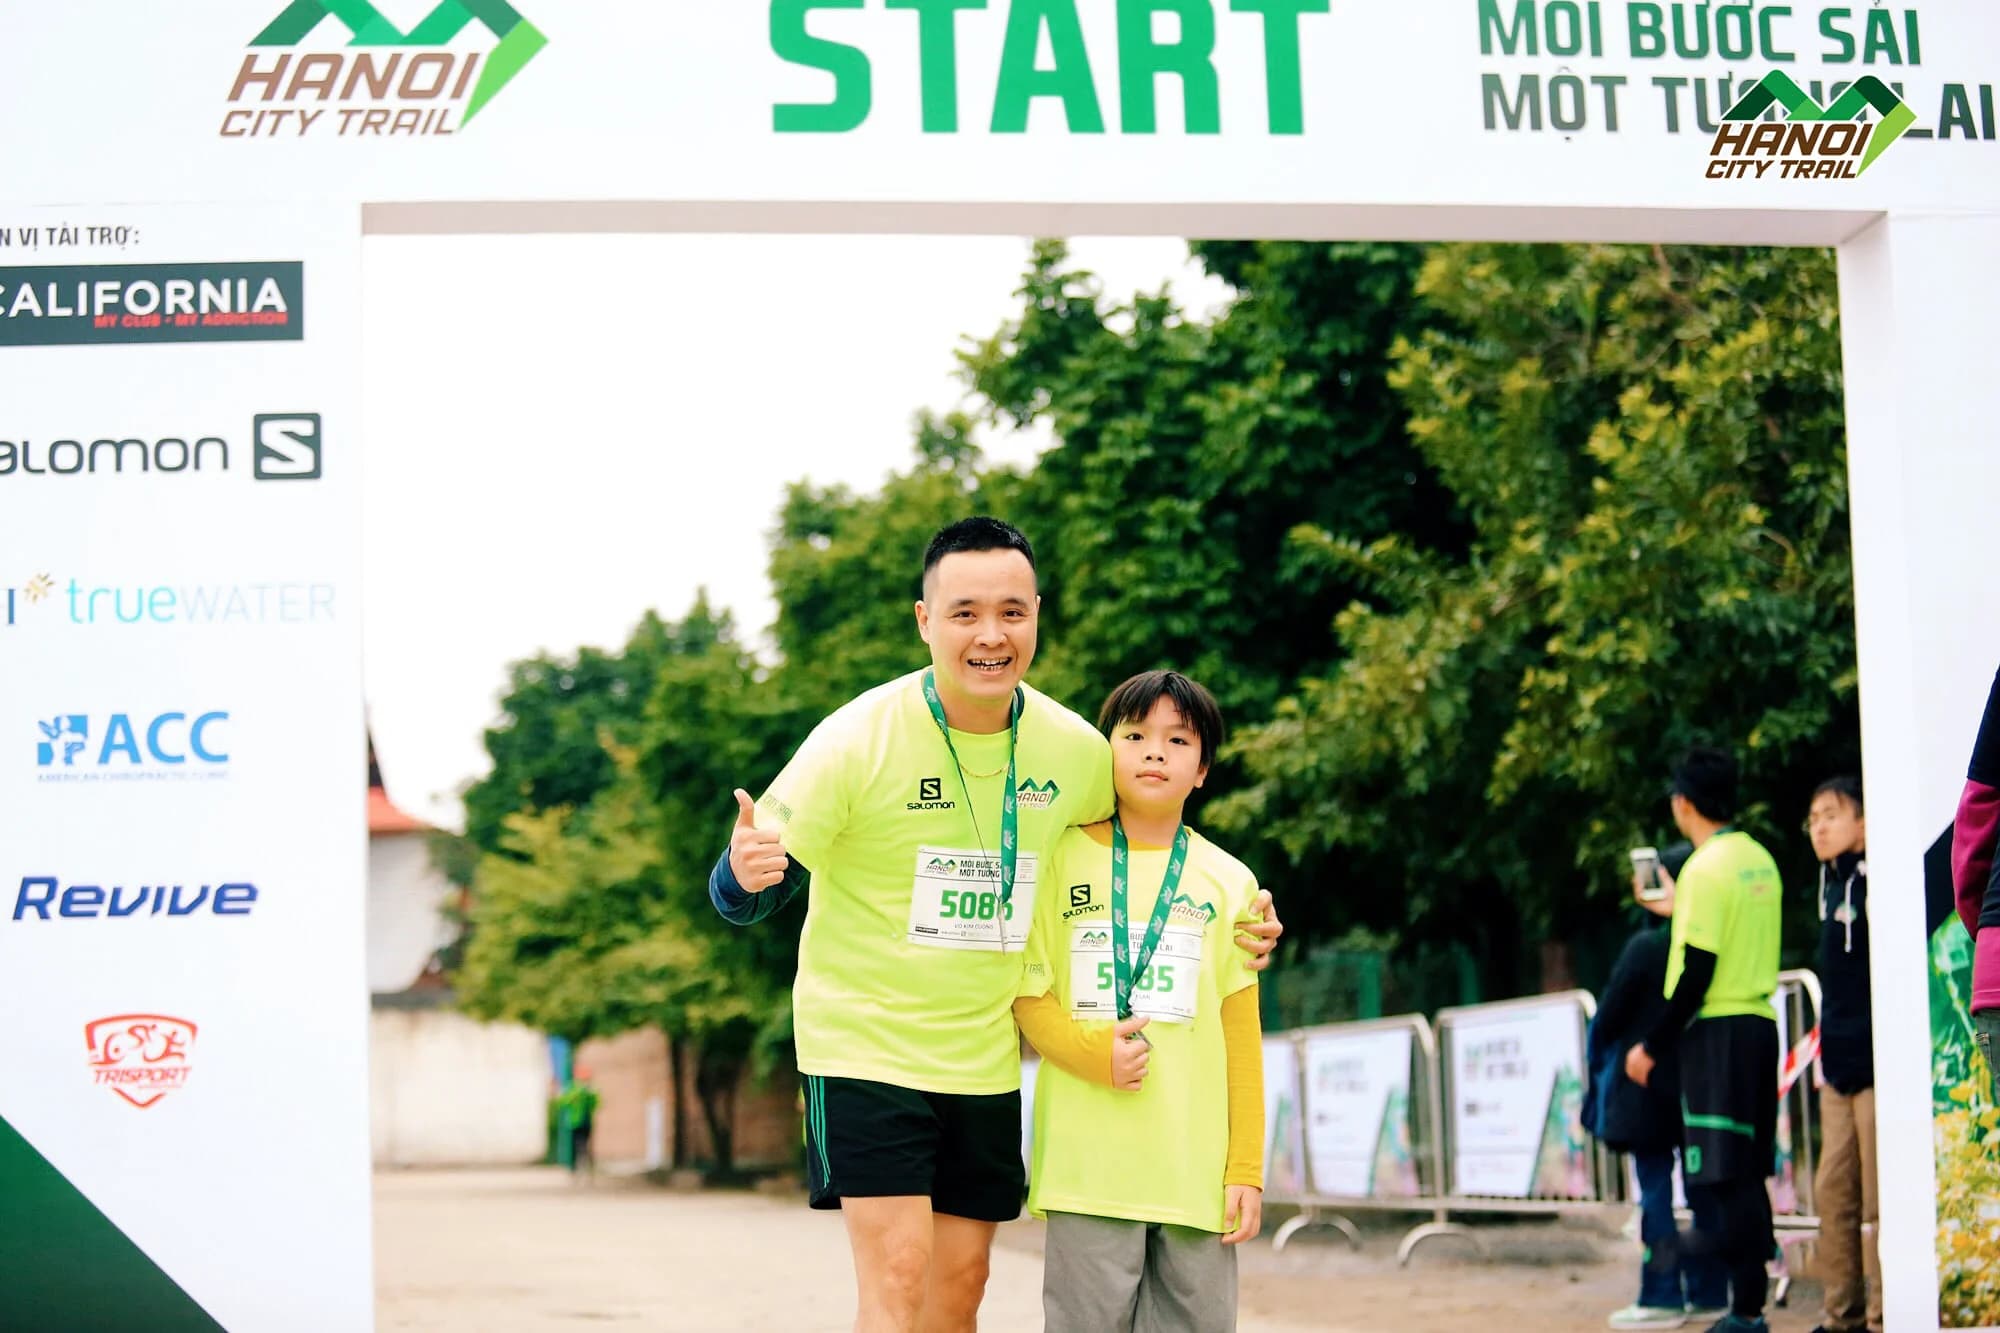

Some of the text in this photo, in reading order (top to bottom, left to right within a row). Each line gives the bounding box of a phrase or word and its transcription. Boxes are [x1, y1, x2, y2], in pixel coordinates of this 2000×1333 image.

[227, 53, 482, 102] HANOI
[769, 0, 1330, 134] START
[1481, 66, 1628, 143] MỘT
[219, 108, 458, 137] CITY TRAIL
[19, 227, 38, 251] VỊ
[94, 312, 288, 328] MY CLUB MY ADDICTION
[0, 437, 229, 475] alomon
[97, 711, 230, 765] ACC
[12, 876, 259, 921] Revive
[940, 890, 1013, 921] 5086
[1097, 962, 1174, 993] 585
[94, 1066, 192, 1084] TRISPORT
